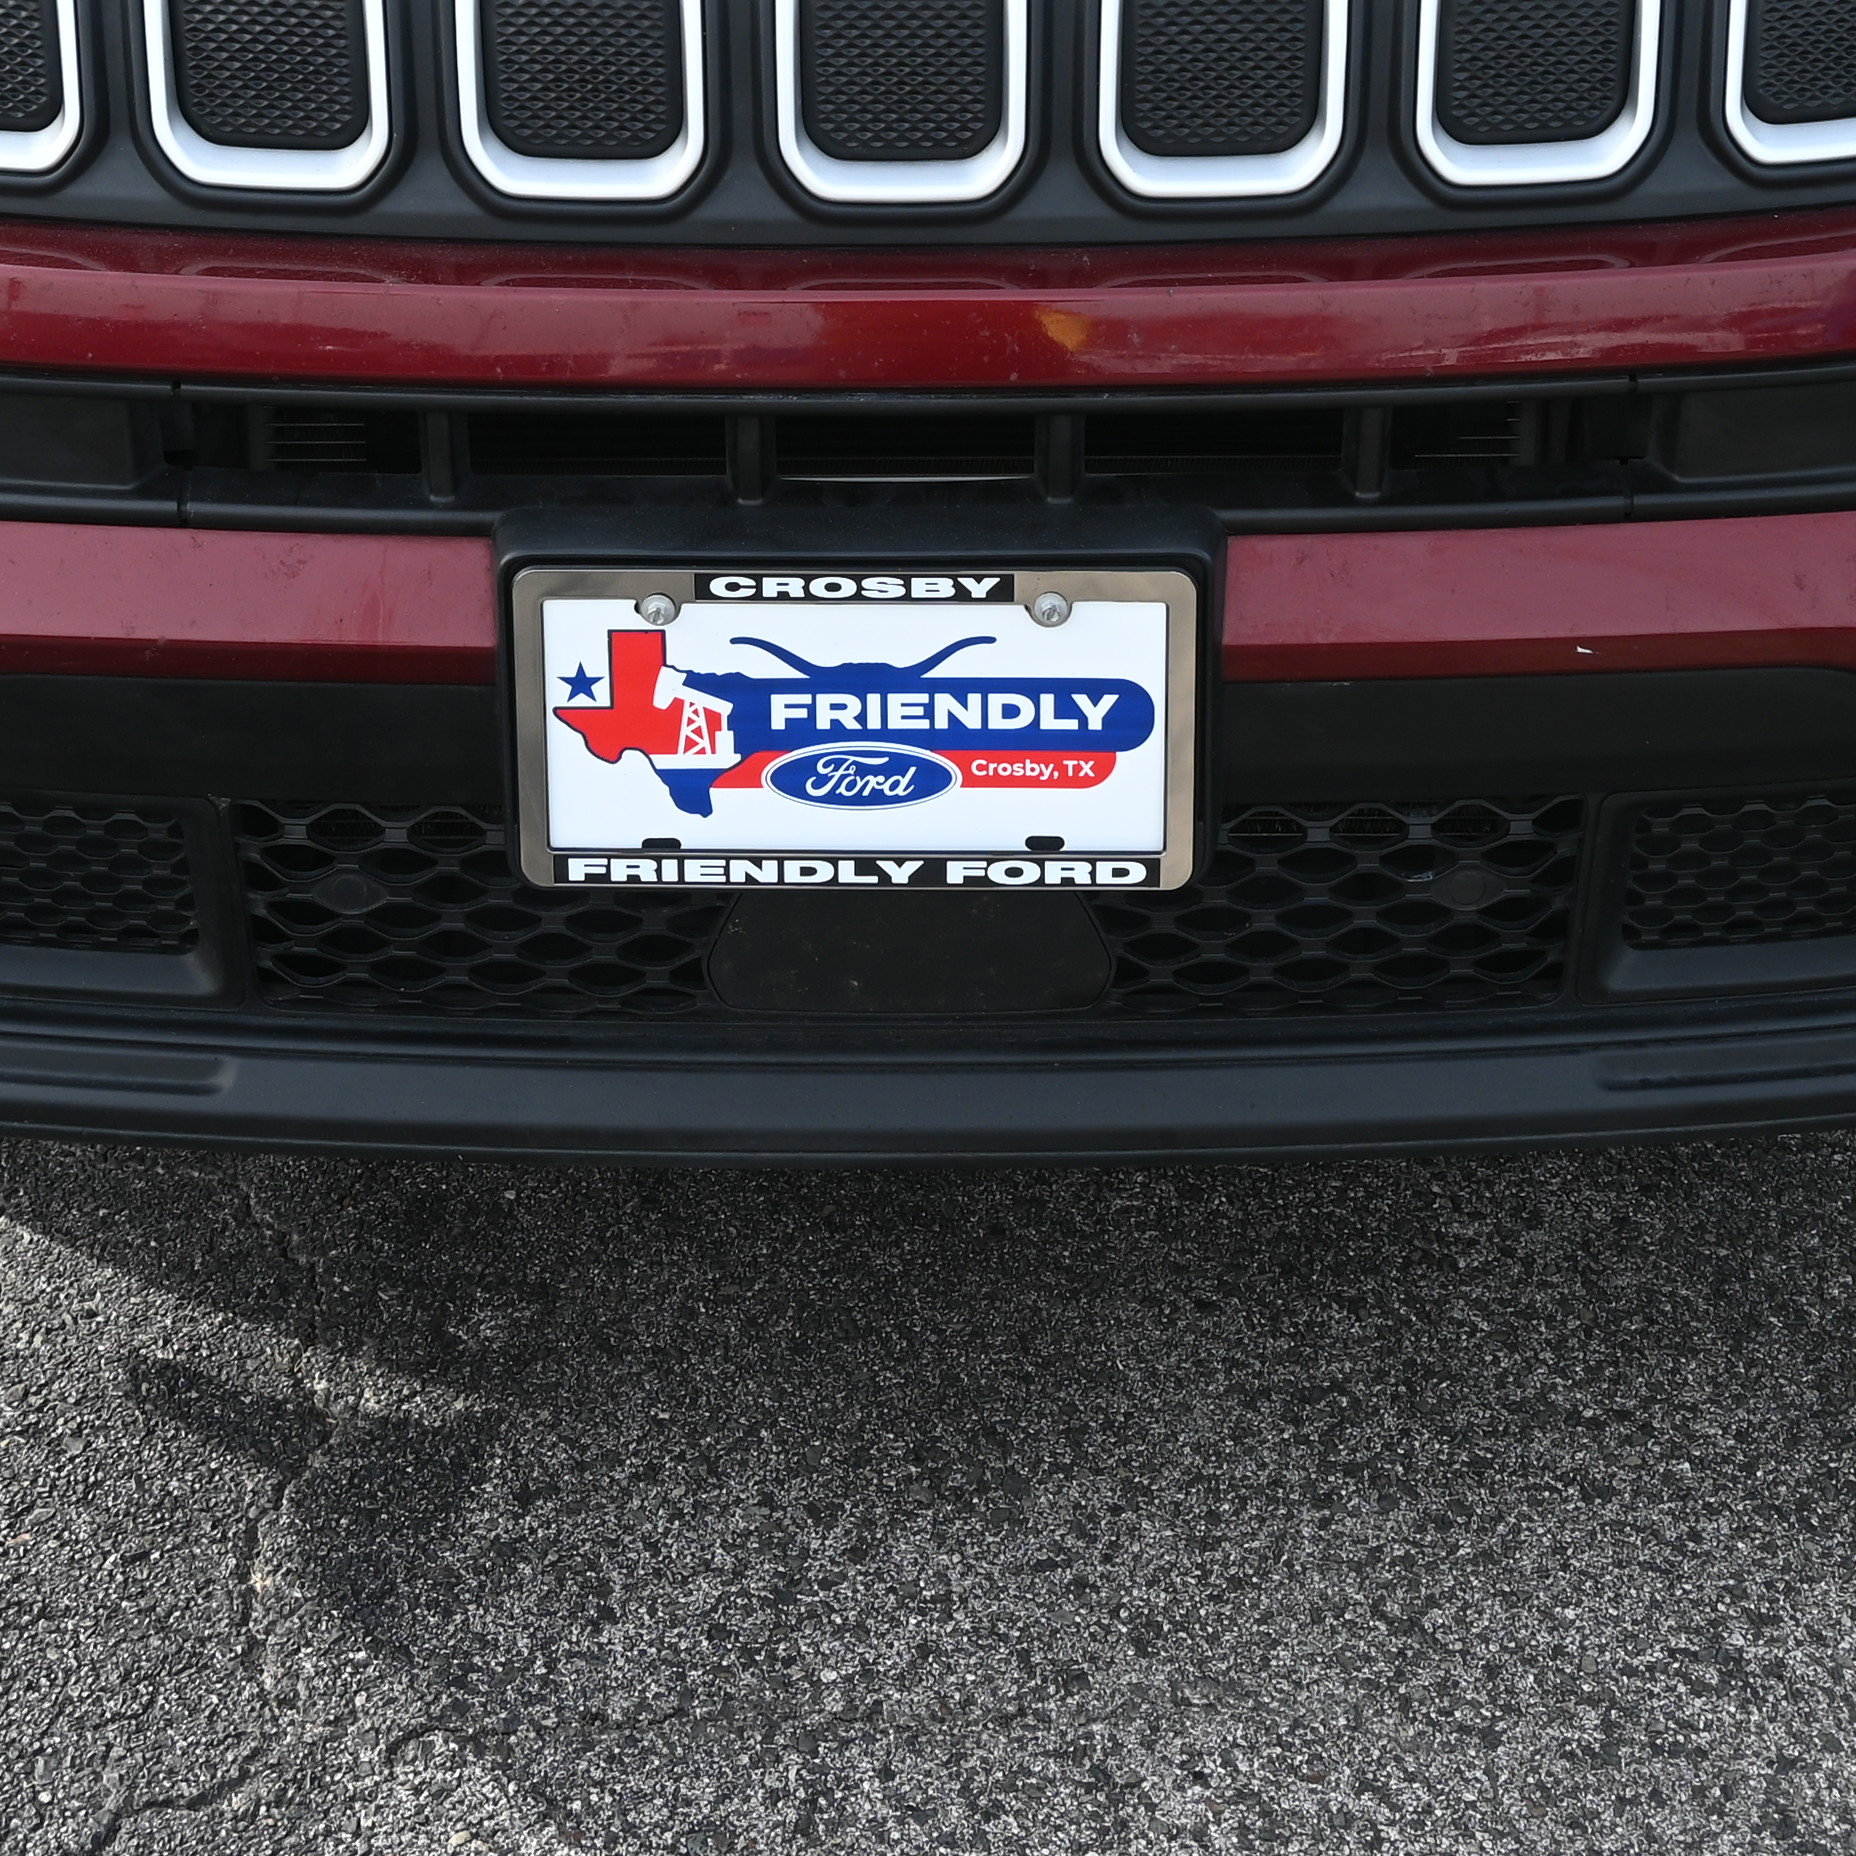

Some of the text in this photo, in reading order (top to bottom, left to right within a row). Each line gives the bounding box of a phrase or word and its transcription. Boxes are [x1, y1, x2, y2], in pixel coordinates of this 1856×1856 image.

[708, 576, 1002, 600] CROSBY
[770, 693, 1121, 731] FRIENDLY
[804, 755, 917, 799] Ford
[970, 758, 1096, 781] Crosby, TX
[567, 858, 1148, 885] FRIENDLY FORD
